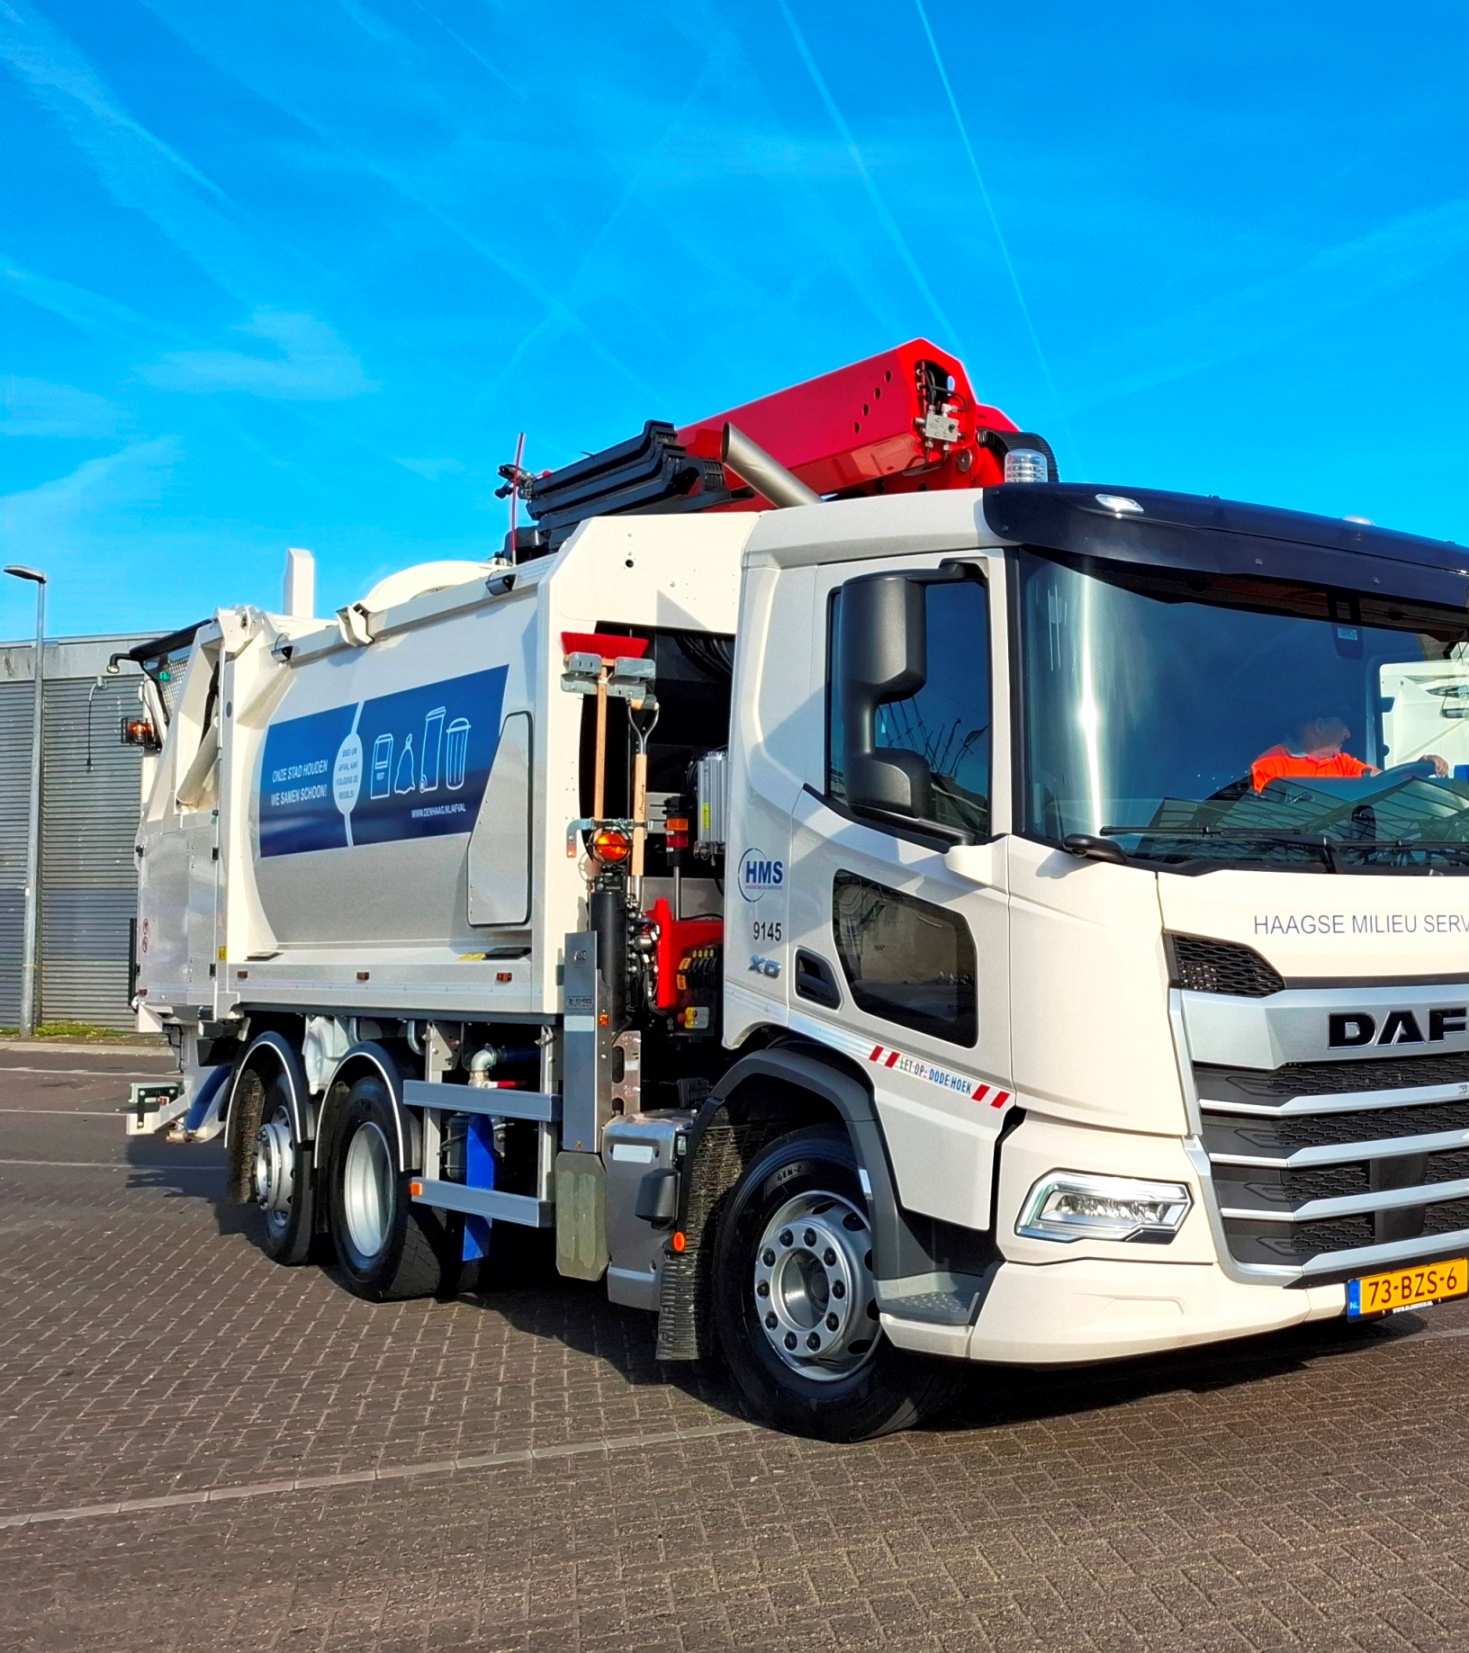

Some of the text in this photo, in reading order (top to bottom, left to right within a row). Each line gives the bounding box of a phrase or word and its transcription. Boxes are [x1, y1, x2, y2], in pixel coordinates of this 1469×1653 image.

[272, 759, 329, 783] ONZE STAD HOUDEN
[271, 792, 280, 806] WE
[280, 788, 300, 805] SAMEN
[745, 860, 783, 885] HMS
[753, 921, 782, 941] 9145
[1254, 914, 1345, 935] HAAGSE
[1352, 914, 1417, 934] MILIEU
[1328, 1006, 1468, 1050] DAF
[900, 1055, 973, 1095] LET OP: DODE HOEK
[1368, 1266, 1458, 1307] 73-BZS-6
[1349, 1301, 1360, 1310] NL
